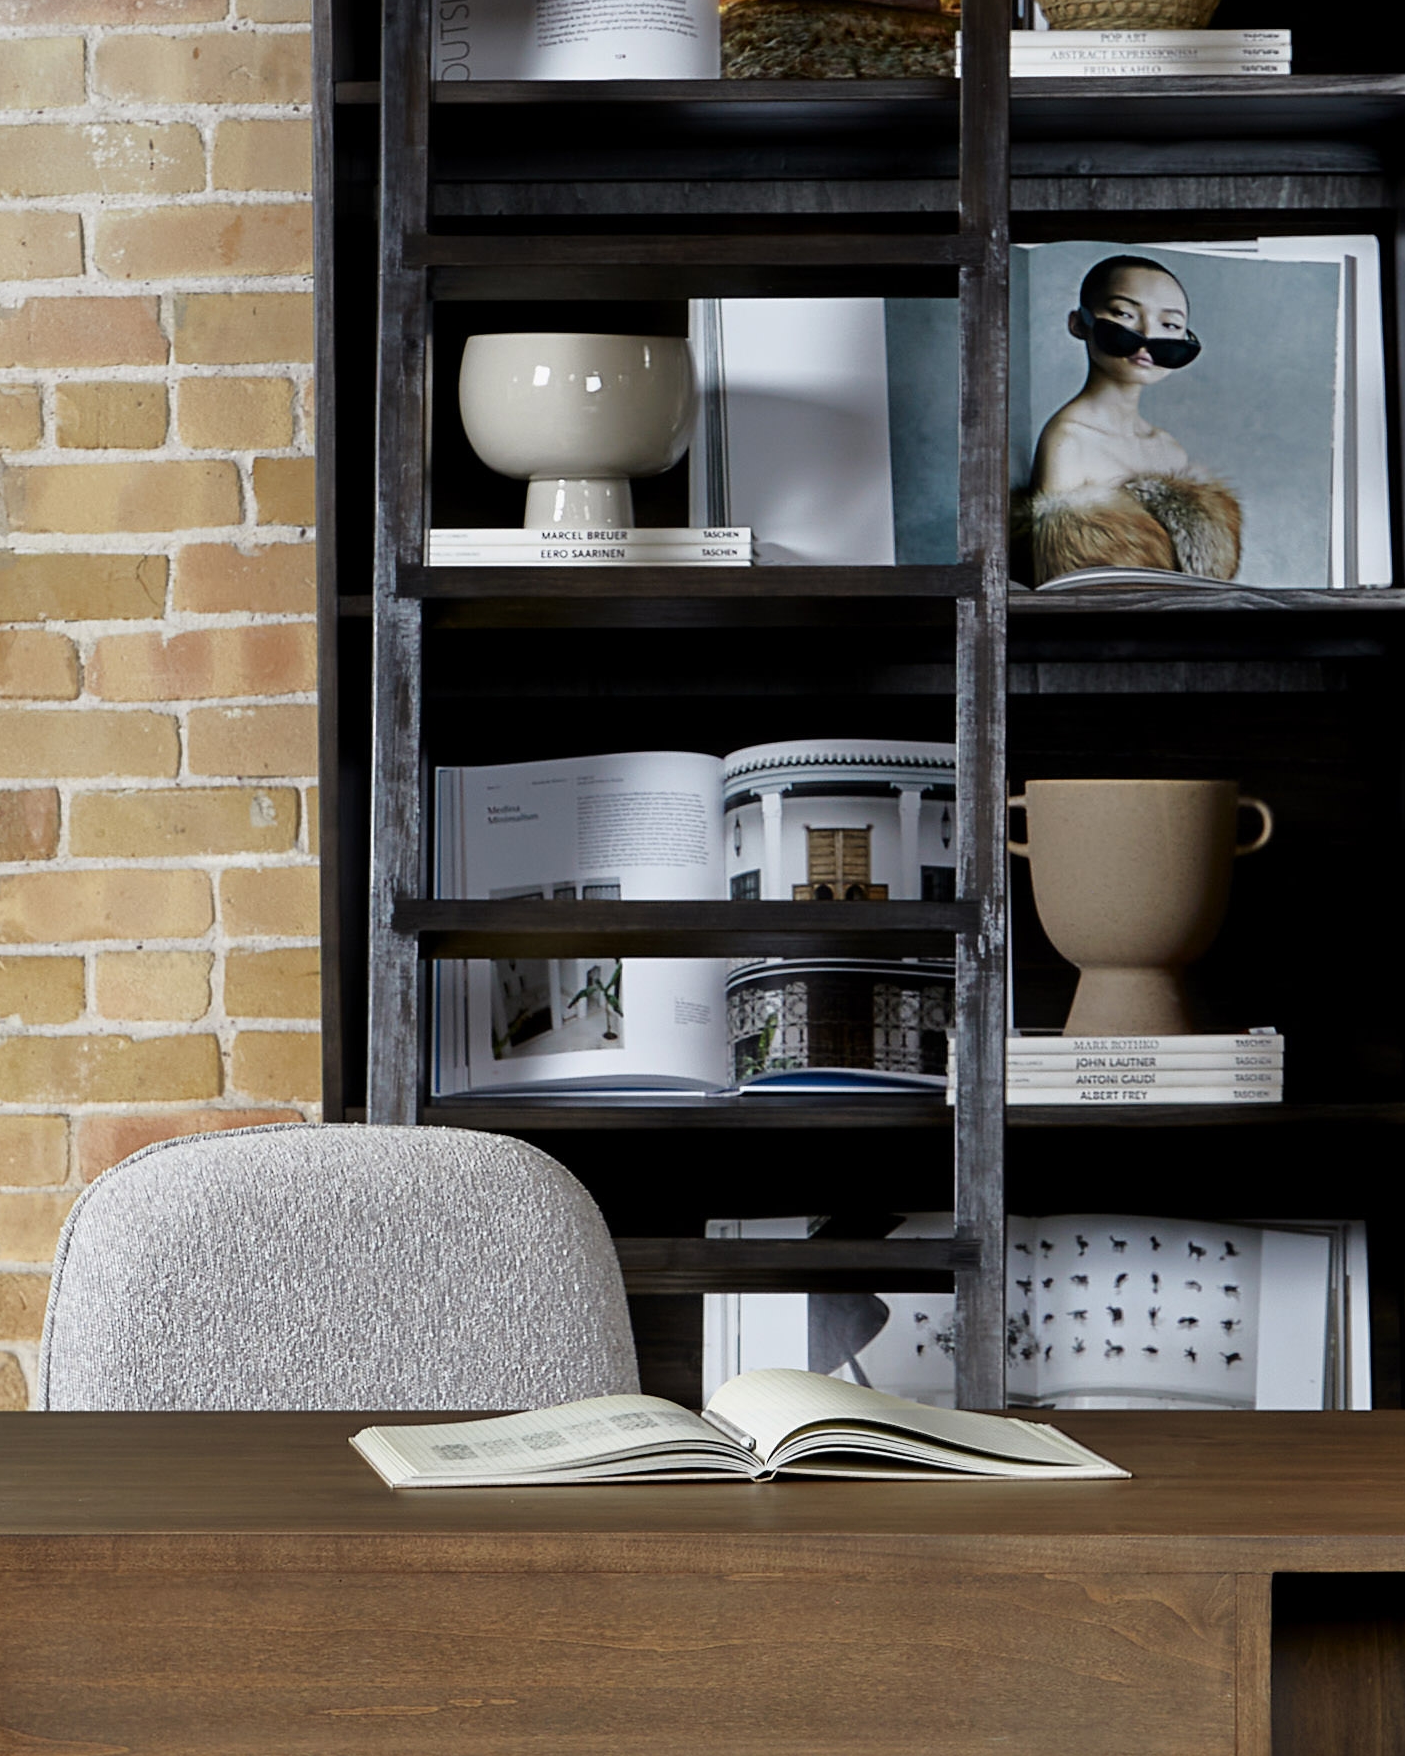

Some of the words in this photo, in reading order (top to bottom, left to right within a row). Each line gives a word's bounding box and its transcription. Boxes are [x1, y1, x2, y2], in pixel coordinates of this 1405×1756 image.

[1100, 32, 1124, 43] POP
[1126, 32, 1148, 43] ART
[1050, 49, 1108, 60] ABSTRACT
[1111, 49, 1198, 60] EXPRESSIONISM
[1083, 65, 1117, 76] FRIDA
[1120, 65, 1161, 75] KAHLO
[541, 530, 583, 541] MARCEL
[586, 530, 628, 541] BREUER
[702, 530, 739, 539] TASCHEN
[540, 548, 568, 559] EERO
[571, 548, 625, 558] SAARINEN
[701, 548, 738, 557] TASCHEN
[1073, 1040, 1108, 1051] MARK
[1111, 1039, 1159, 1050] ROTHKO
[1076, 1057, 1106, 1068] JOHN
[1109, 1057, 1156, 1068] LAUTNER
[1076, 1074, 1119, 1085] ANTONI
[1080, 1090, 1119, 1101] ALBERT
[1122, 1090, 1148, 1101] FREY
